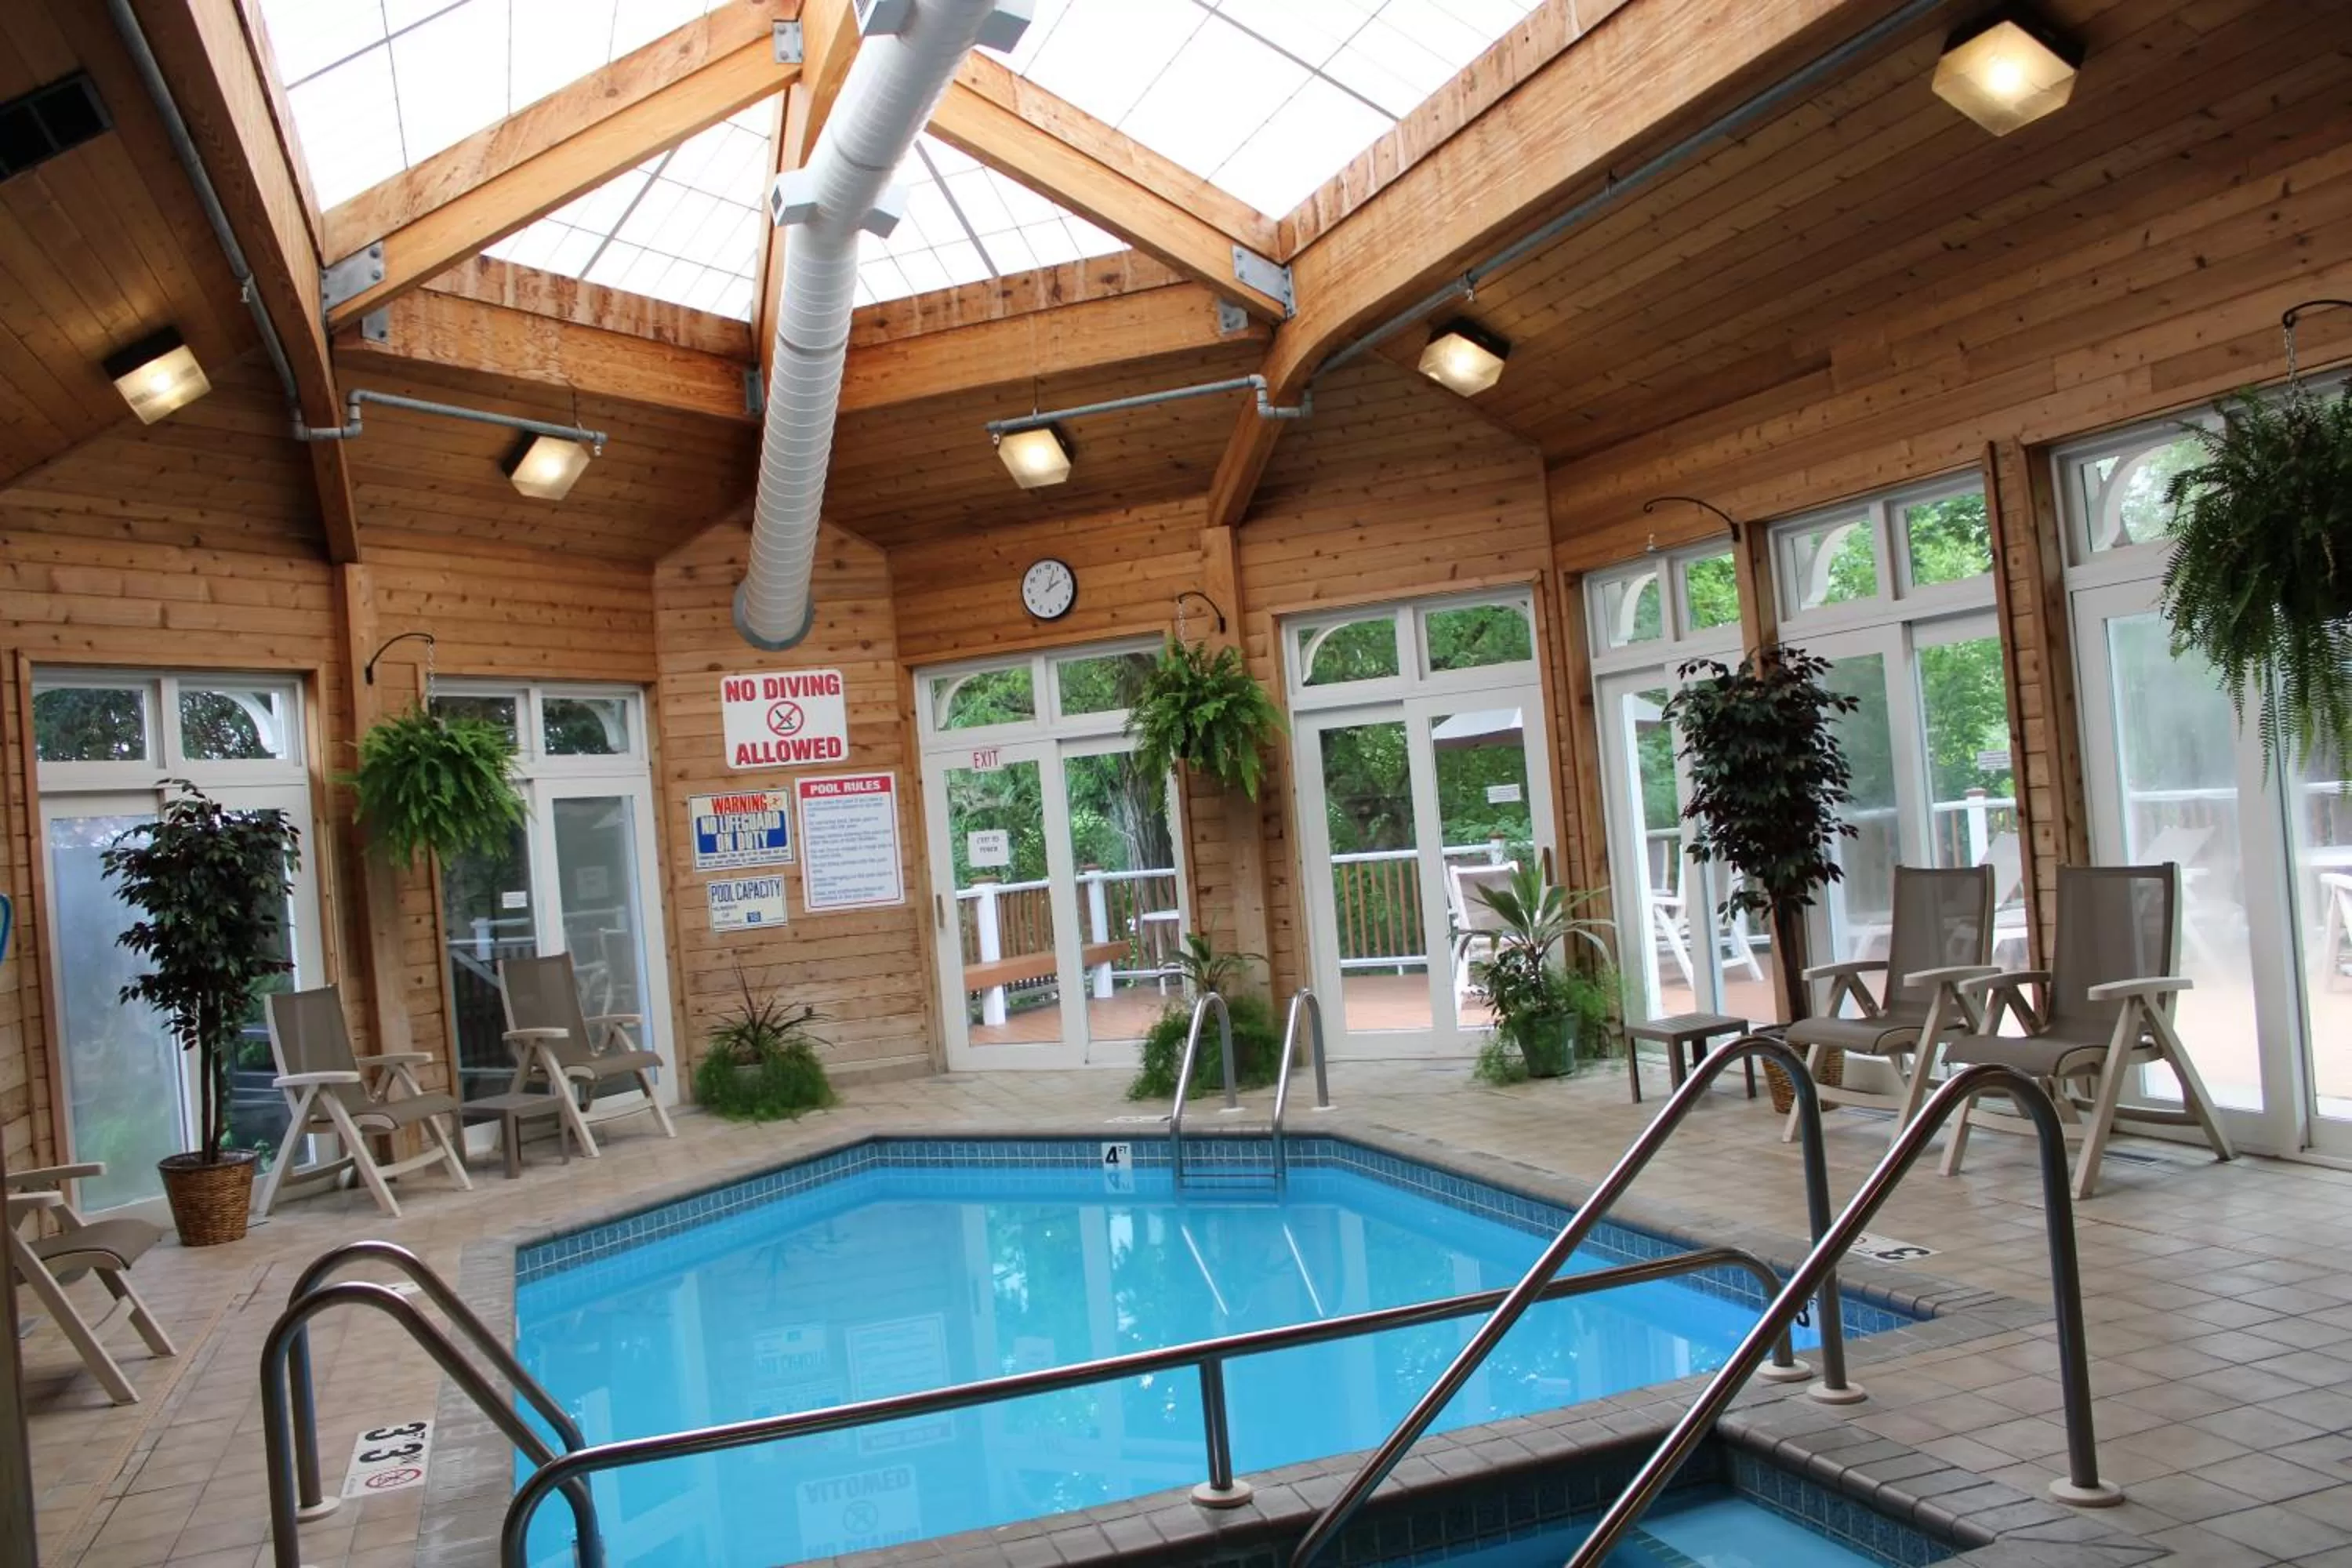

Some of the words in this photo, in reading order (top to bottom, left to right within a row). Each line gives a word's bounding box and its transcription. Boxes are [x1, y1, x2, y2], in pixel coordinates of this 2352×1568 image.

[724, 680, 756, 702] NO
[764, 673, 840, 700] DIVING
[735, 736, 842, 765] ALLOWED
[973, 750, 1000, 769] EXIT
[810, 783, 840, 796] POOL
[844, 780, 880, 793] RULES
[711, 793, 768, 815] WARNING
[711, 884, 735, 903] POOL
[735, 879, 780, 900] CAPACITY
[1105, 1145, 1120, 1164] 4
[1875, 1247, 1930, 1260] 3
